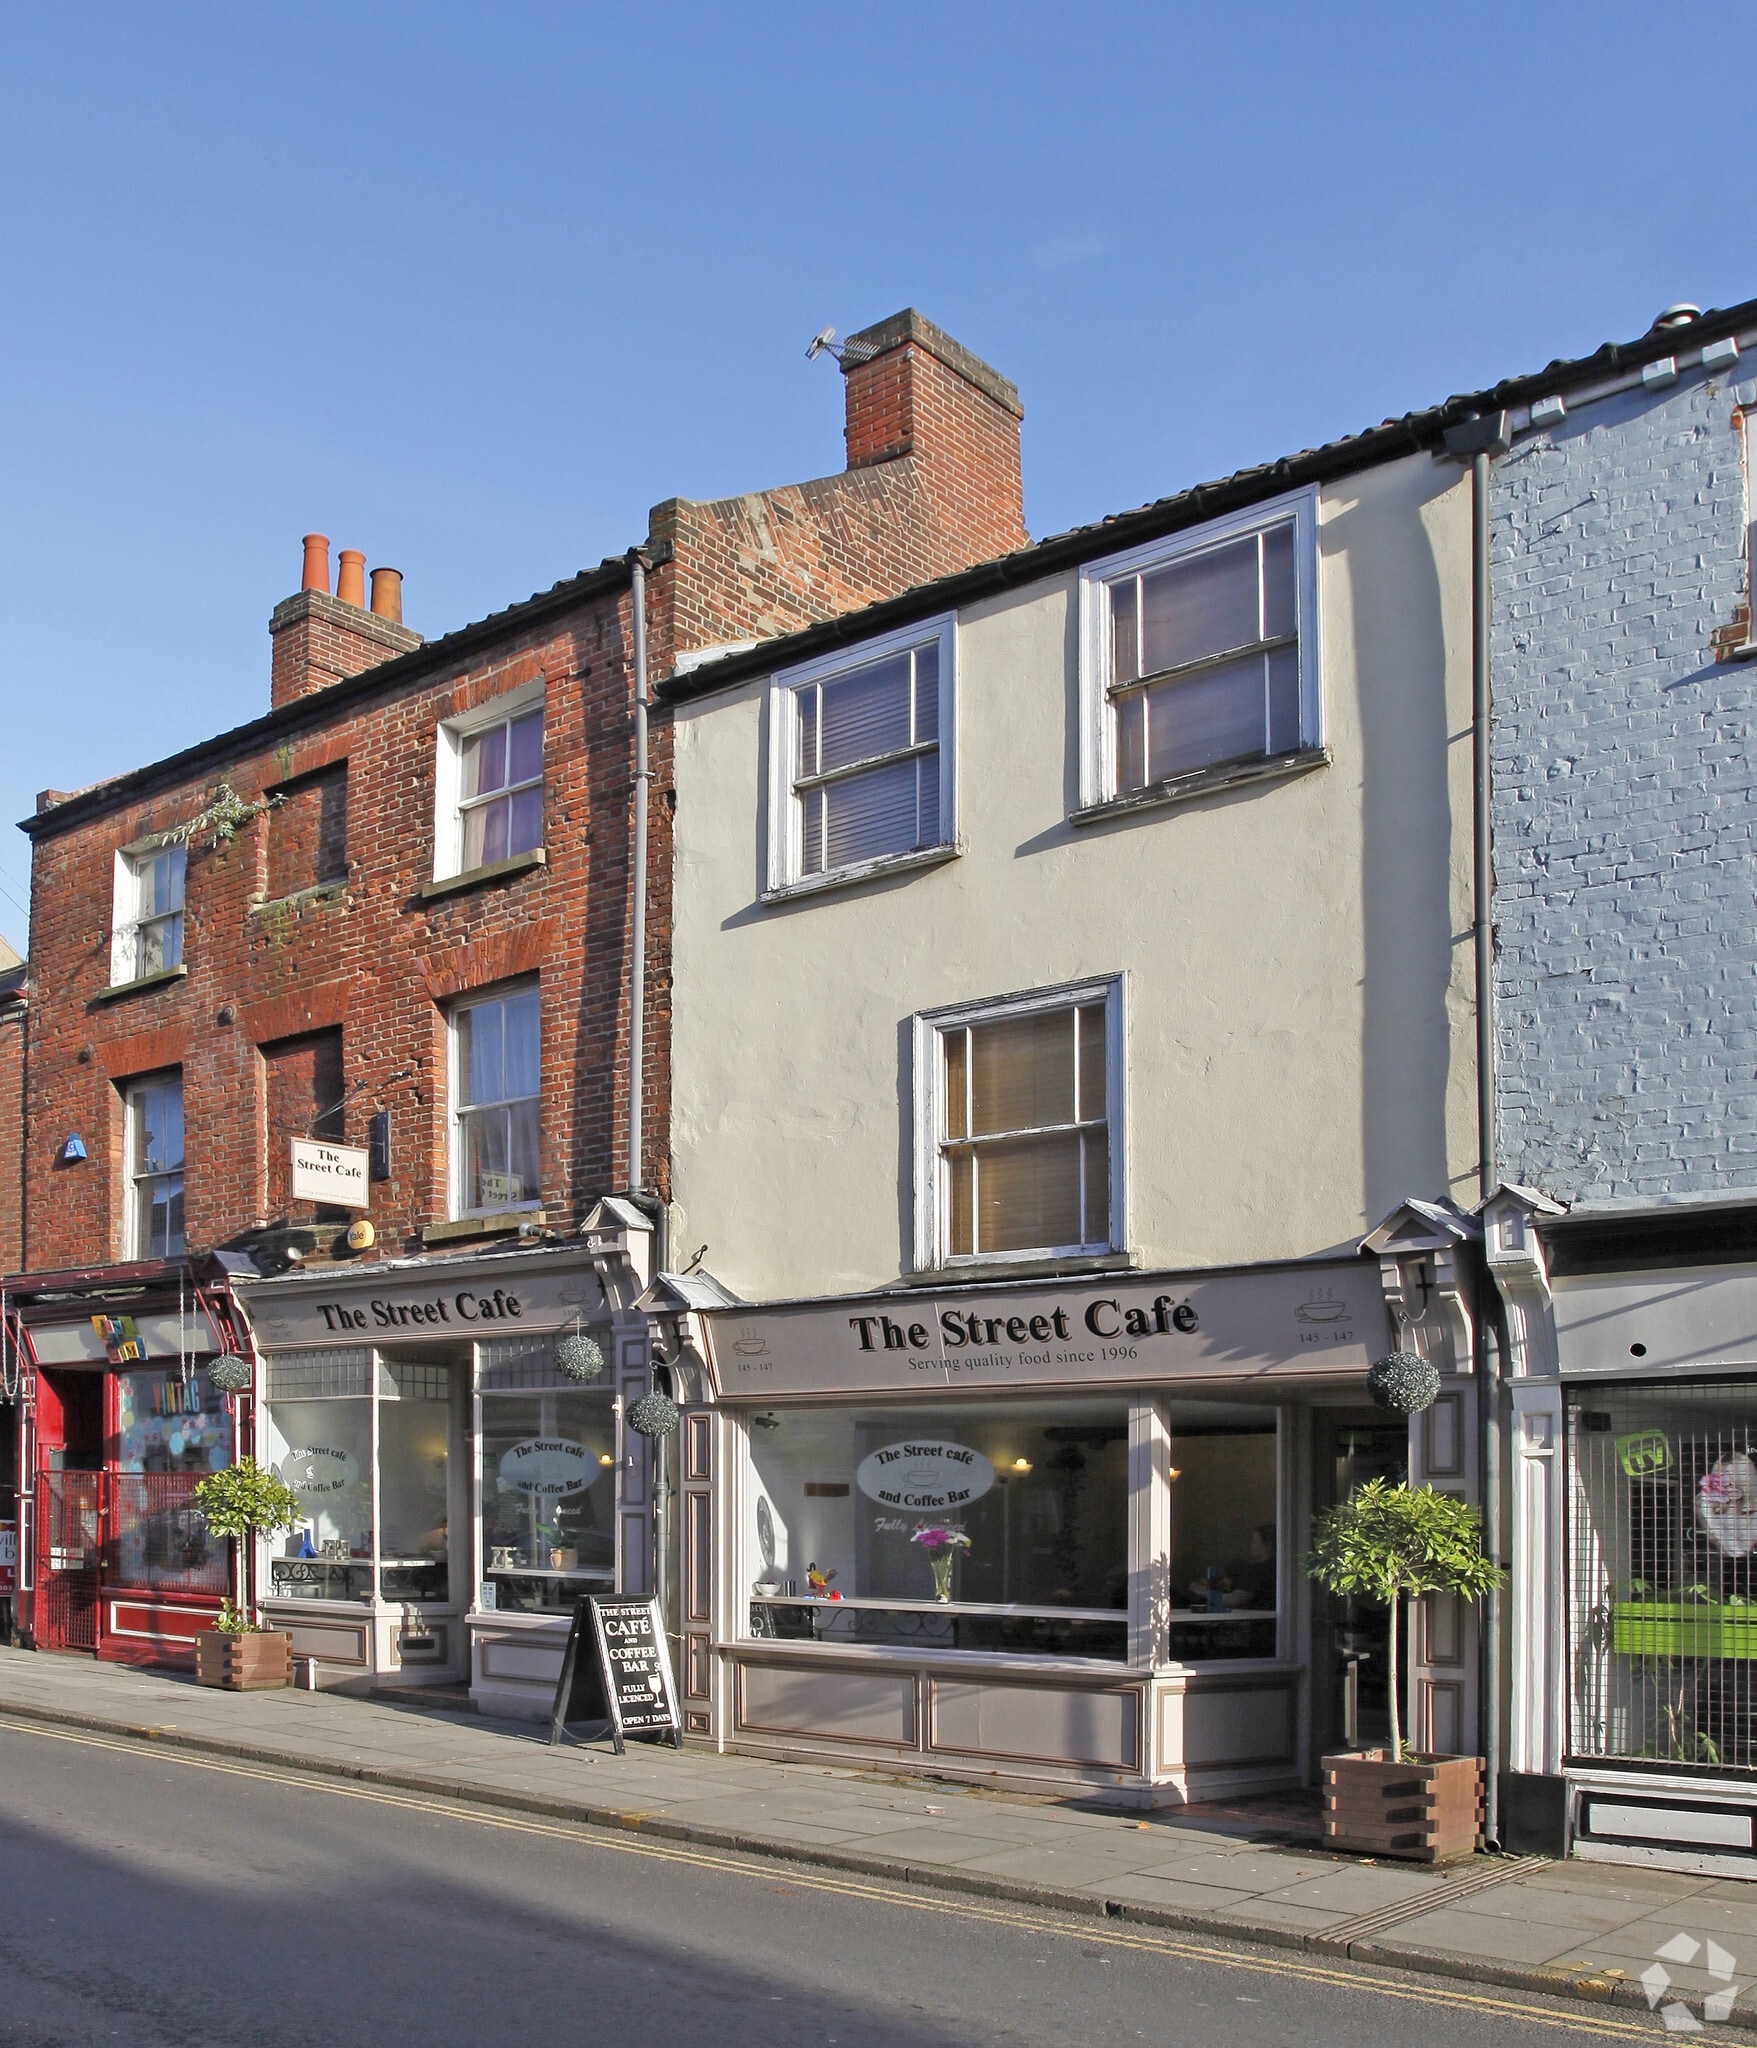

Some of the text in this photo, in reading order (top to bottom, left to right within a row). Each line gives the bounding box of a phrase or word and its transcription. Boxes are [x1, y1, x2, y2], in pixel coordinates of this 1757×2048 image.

[317, 1149, 340, 1163] The
[297, 1158, 332, 1174] Street
[316, 1289, 523, 1331] The Street Café
[849, 1294, 1200, 1353] The Street Café
[1334, 1331, 1353, 1341] 147
[908, 1345, 1138, 1372] Serving quality food since 1996
[760, 1362, 773, 1372] 147
[307, 1445, 330, 1457] Street
[513, 1445, 533, 1459] The
[534, 1440, 563, 1452] Street
[875, 1444, 974, 1466] The Street café
[307, 1482, 330, 1493] Coffee
[332, 1479, 345, 1490] Bar
[516, 1478, 584, 1494] and Coffee Bar
[878, 1487, 970, 1507] and Coffee Bar
[874, 1517, 908, 1533] Fully
[600, 1607, 651, 1617] THE STREET
[605, 1616, 651, 1636] CAFÉ
[610, 1646, 657, 1660] COFFEE
[622, 1660, 650, 1673] BAR
[622, 1684, 646, 1694] FULLY
[618, 1693, 654, 1704] LICENCED
[622, 1713, 671, 1725] OPEN 7 DAYS
